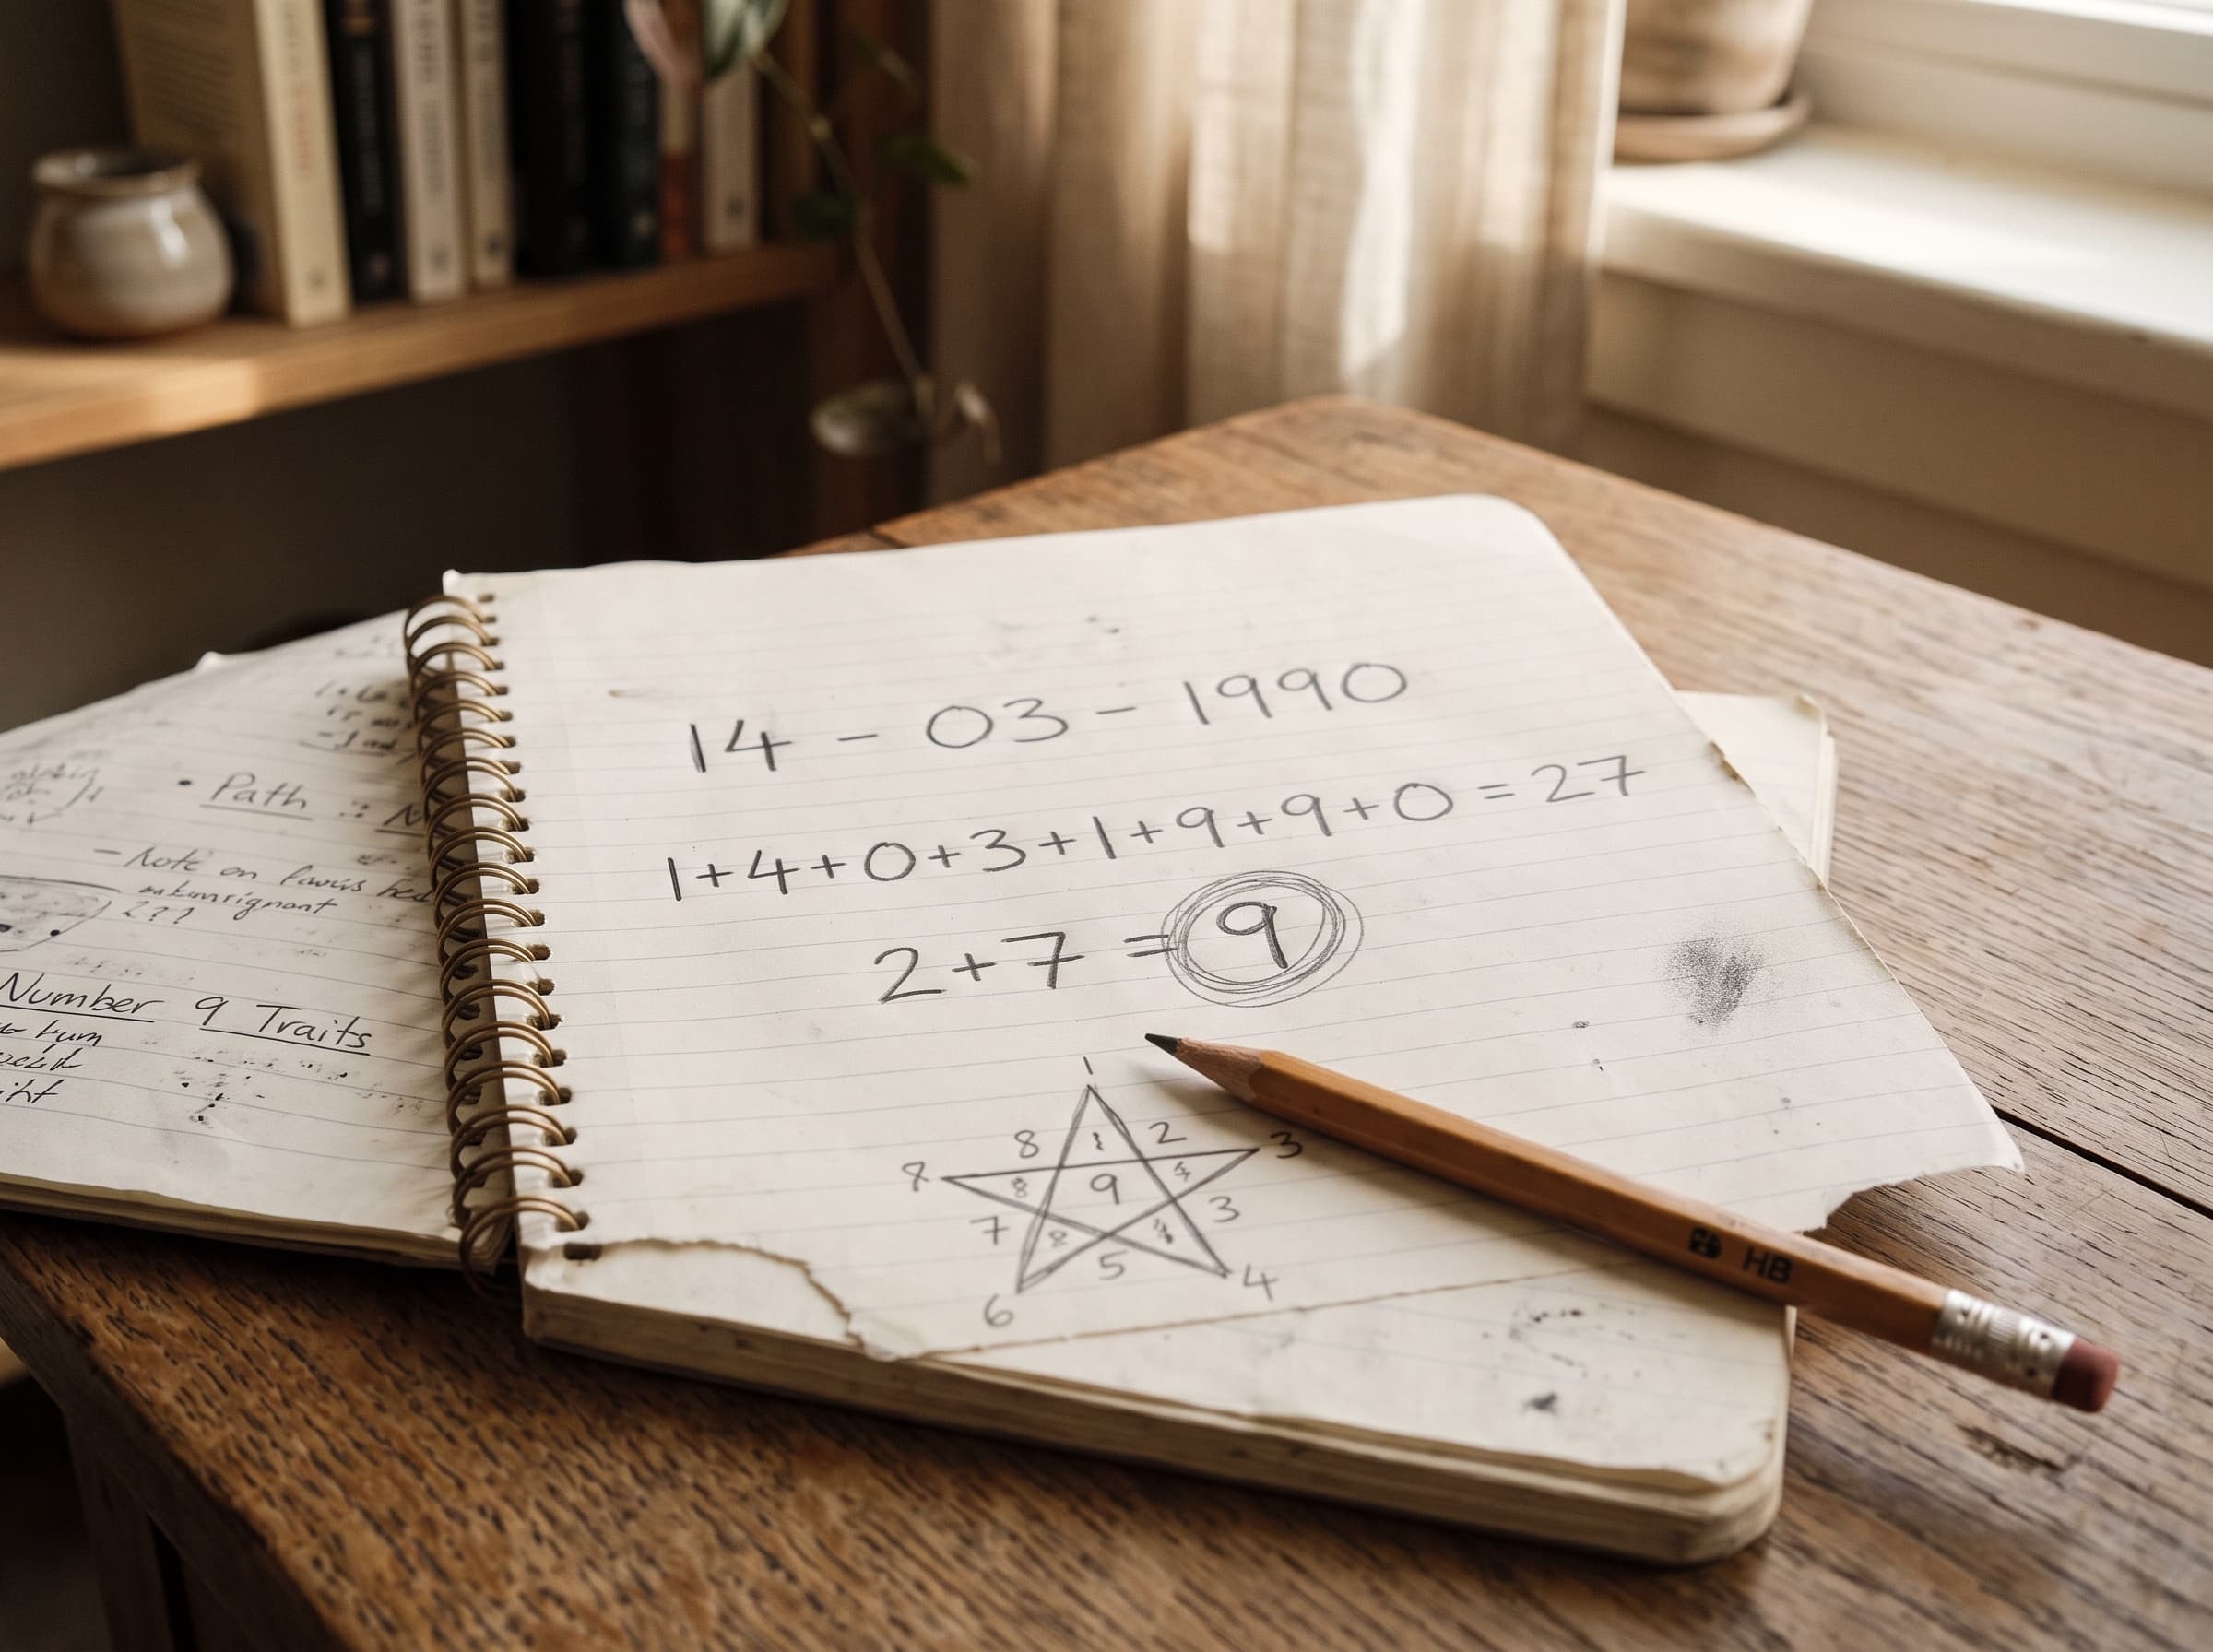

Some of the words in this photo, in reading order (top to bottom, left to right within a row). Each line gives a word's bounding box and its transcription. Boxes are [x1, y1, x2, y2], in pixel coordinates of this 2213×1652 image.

[691, 719, 793, 773] 14
[926, 698, 1070, 749] 03
[1183, 663, 1408, 726] 1990
[210, 772, 307, 809] Path
[1215, 900, 1289, 970] 9
[0, 972, 166, 1014] Number
[195, 996, 230, 1027] 9
[255, 1004, 373, 1049] Traits
[1013, 1129, 1040, 1160] 8
[1148, 1121, 1188, 1145] 2
[1272, 1131, 1305, 1160] 3
[1089, 1173, 1121, 1206] 9
[1209, 1195, 1241, 1223] 3
[970, 1215, 1010, 1245] 7
[1098, 1249, 1129, 1280] 5
[1742, 1245, 1793, 1284] HB
[1242, 1263, 1278, 1301] 4
[983, 1293, 1014, 1328] 6
